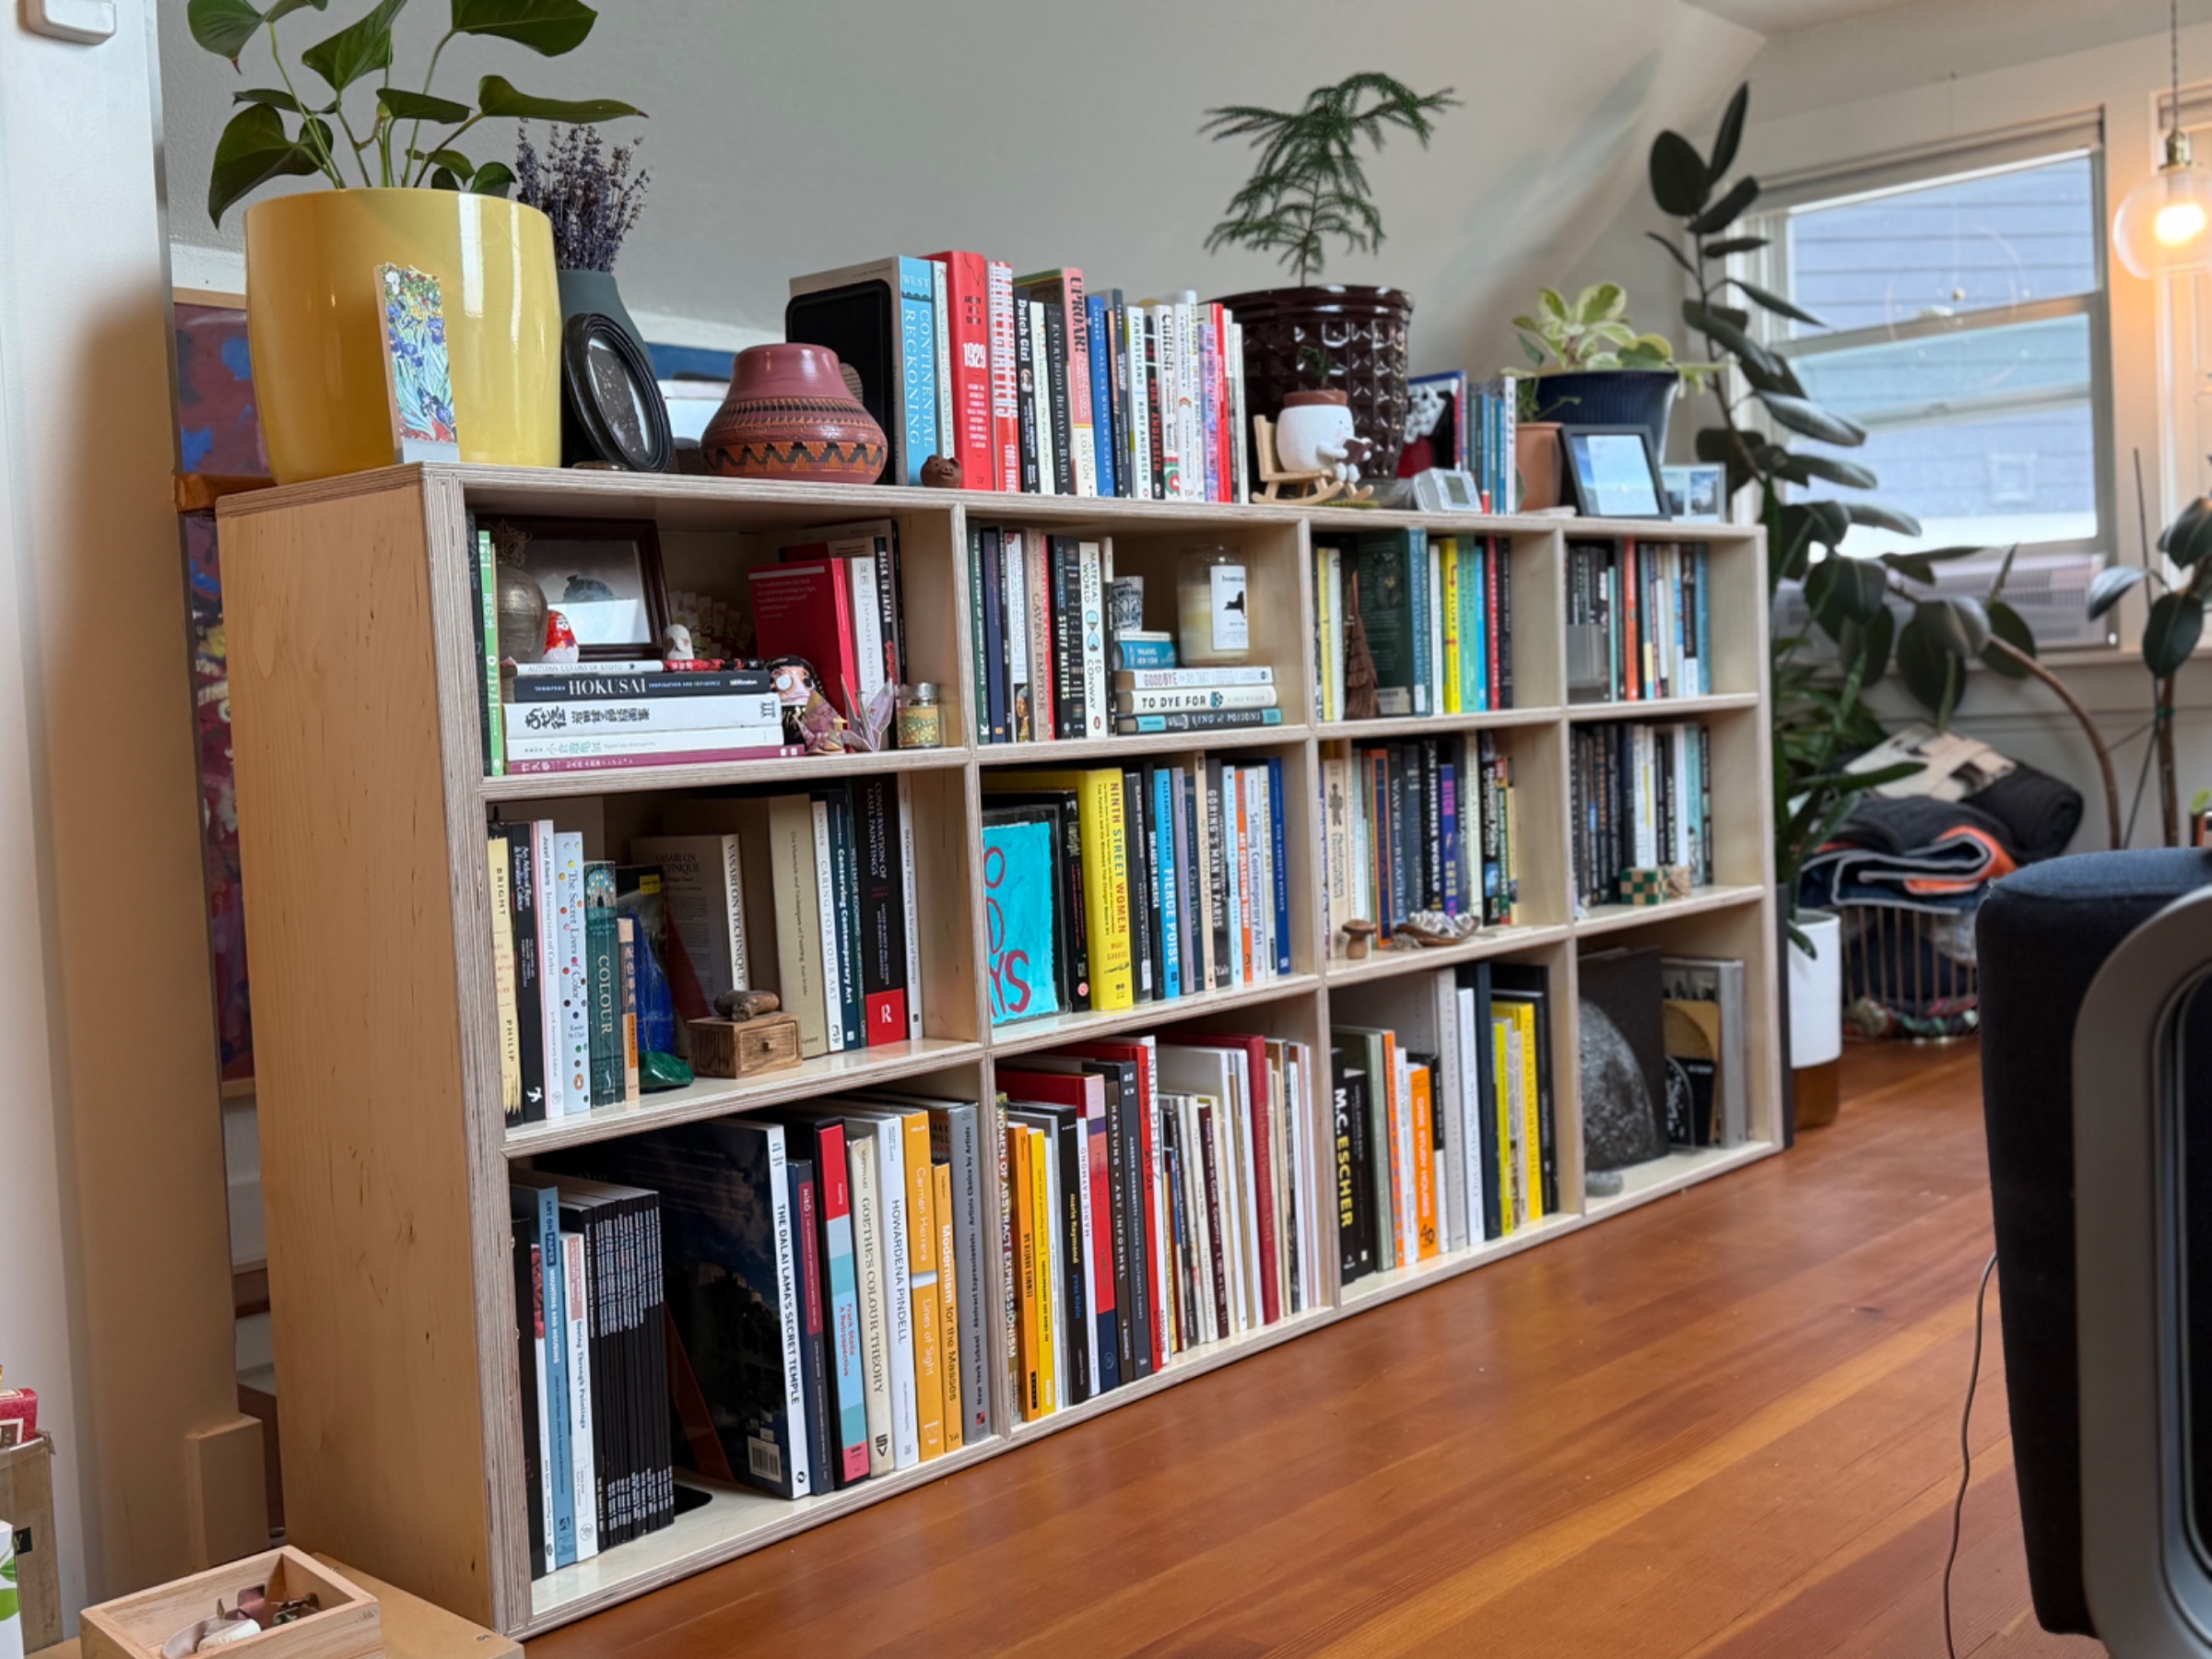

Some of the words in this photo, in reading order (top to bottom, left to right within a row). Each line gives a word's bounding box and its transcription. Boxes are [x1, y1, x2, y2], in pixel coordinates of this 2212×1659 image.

[902, 274, 930, 288] WEST
[1018, 299, 1029, 336] Dutch
[1070, 276, 1087, 353] UPROAR!
[962, 342, 986, 370] 1929
[1019, 339, 1030, 362] Girl
[1052, 323, 1064, 393] EVERYBODY
[1133, 315, 1144, 385] FANTASYLAND
[1162, 314, 1175, 371] Cultish
[905, 310, 920, 444] RECKONING
[919, 309, 934, 449] CONTINENTAL
[1149, 378, 1159, 407] KURT
[1054, 394, 1066, 446] BEHAVES
[1137, 400, 1147, 428] KURT
[1139, 429, 1149, 482] ANDERSEN
[1152, 412, 1162, 472] ANDERSEN
[1058, 448, 1071, 485] BADLY
[878, 551, 888, 576] BACK
[1082, 563, 1091, 604] WORLD
[1090, 551, 1100, 604] MATERIAL
[882, 594, 892, 623] JAPAN
[1032, 593, 1044, 649] CAVEAT
[1449, 592, 1458, 632] FLUKE
[1058, 615, 1068, 648] STUFF
[568, 678, 646, 696] HOKUSAI
[1036, 652, 1047, 712] EMPTOR
[1060, 652, 1071, 700] MATTERS
[1087, 659, 1097, 710] CONWAY
[1094, 659, 1102, 674] ED
[1142, 698, 1156, 709] TO
[1160, 696, 1181, 708] DYE
[1186, 695, 1207, 707] FOR
[1428, 747, 1438, 769] AN
[1111, 782, 1122, 823] NINTH
[1391, 778, 1402, 831] WAVES
[1429, 772, 1440, 838] IMMENSE
[1441, 781, 1455, 817] BITCH
[874, 782, 887, 861] CONSERVATION
[1238, 831, 1248, 848] ART
[1250, 812, 1261, 849] Selling
[727, 842, 739, 887] VASARI
[867, 818, 880, 877] PAINTINGS
[1113, 829, 1124, 878] STREET
[1210, 848, 1222, 873] MAN
[1431, 841, 1441, 892] WORLD
[568, 871, 579, 890] The
[819, 860, 831, 908] CARING
[837, 849, 849, 909] Conserving
[877, 864, 888, 880] OF
[1164, 867, 1175, 918] FIERCE
[1211, 877, 1221, 889] IN
[1239, 850, 1250, 901] COLLECTING
[1250, 851, 1264, 927] Contemporary
[1394, 846, 1406, 918] BEACHES
[569, 892, 580, 925] Secret
[731, 888, 740, 903] ON
[1115, 882, 1127, 934] WOMEN
[1212, 894, 1224, 928] PARIS
[1242, 902, 1251, 929] TODAY
[570, 927, 581, 955] Lives
[824, 912, 834, 936] FOR
[1167, 922, 1178, 966] POISE
[1253, 929, 1264, 946] Art
[496, 868, 506, 916] BRIGHT
[506, 1019, 516, 1063] PHILIP
[732, 911, 747, 985] TECHNIQUE
[827, 940, 835, 973] YOUR
[840, 910, 853, 985] Contemporary
[571, 971, 582, 1000] Color
[596, 955, 614, 1035] COLOUR
[829, 979, 838, 1001] ART
[845, 986, 853, 1004] Art
[996, 1106, 1008, 1159] WOMEN
[1335, 1087, 1347, 1135] M.C.
[1416, 1096, 1427, 1128] CASE
[1110, 1104, 1120, 1166] HARTUNG
[1418, 1130, 1429, 1169] STUDY
[916, 1166, 927, 1216] Carmen
[999, 1161, 1009, 1179] OF
[1336, 1135, 1353, 1228] ESCHER
[777, 1203, 787, 1226] THE
[1000, 1182, 1013, 1248] ABSTRACT
[1115, 1184, 1124, 1209] ART
[1419, 1171, 1431, 1218] HOUSES
[547, 1234, 557, 1262] PAPER
[779, 1228, 790, 1264] DALAI
[861, 1196, 875, 1269] GOETHE'S
[891, 1199, 904, 1286] HOWARDENA
[918, 1218, 930, 1262] Herrera
[1070, 1219, 1080, 1265] Raymond
[1115, 1214, 1126, 1281] INFORMEL
[940, 1223, 955, 1303] Modernism
[782, 1265, 793, 1309] LAMA'S
[865, 1270, 879, 1330] COLOUR
[1004, 1251, 1018, 1359] EXPRESSIONISM
[784, 1311, 795, 1355] SECRET
[846, 1302, 855, 1327] Frank
[895, 1287, 907, 1345] PINDELL
[923, 1298, 934, 1332] Lines
[945, 1305, 956, 1321] for
[947, 1323, 958, 1347] the
[841, 1312, 852, 1375] Retrospective
[847, 1330, 857, 1356] Stella
[924, 1333, 934, 1343] of
[574, 1348, 585, 1386] Through
[788, 1357, 800, 1404] TEMPLE
[870, 1334, 884, 1394] THEORY
[924, 1346, 936, 1376] Sight
[947, 1349, 959, 1401] Masses
